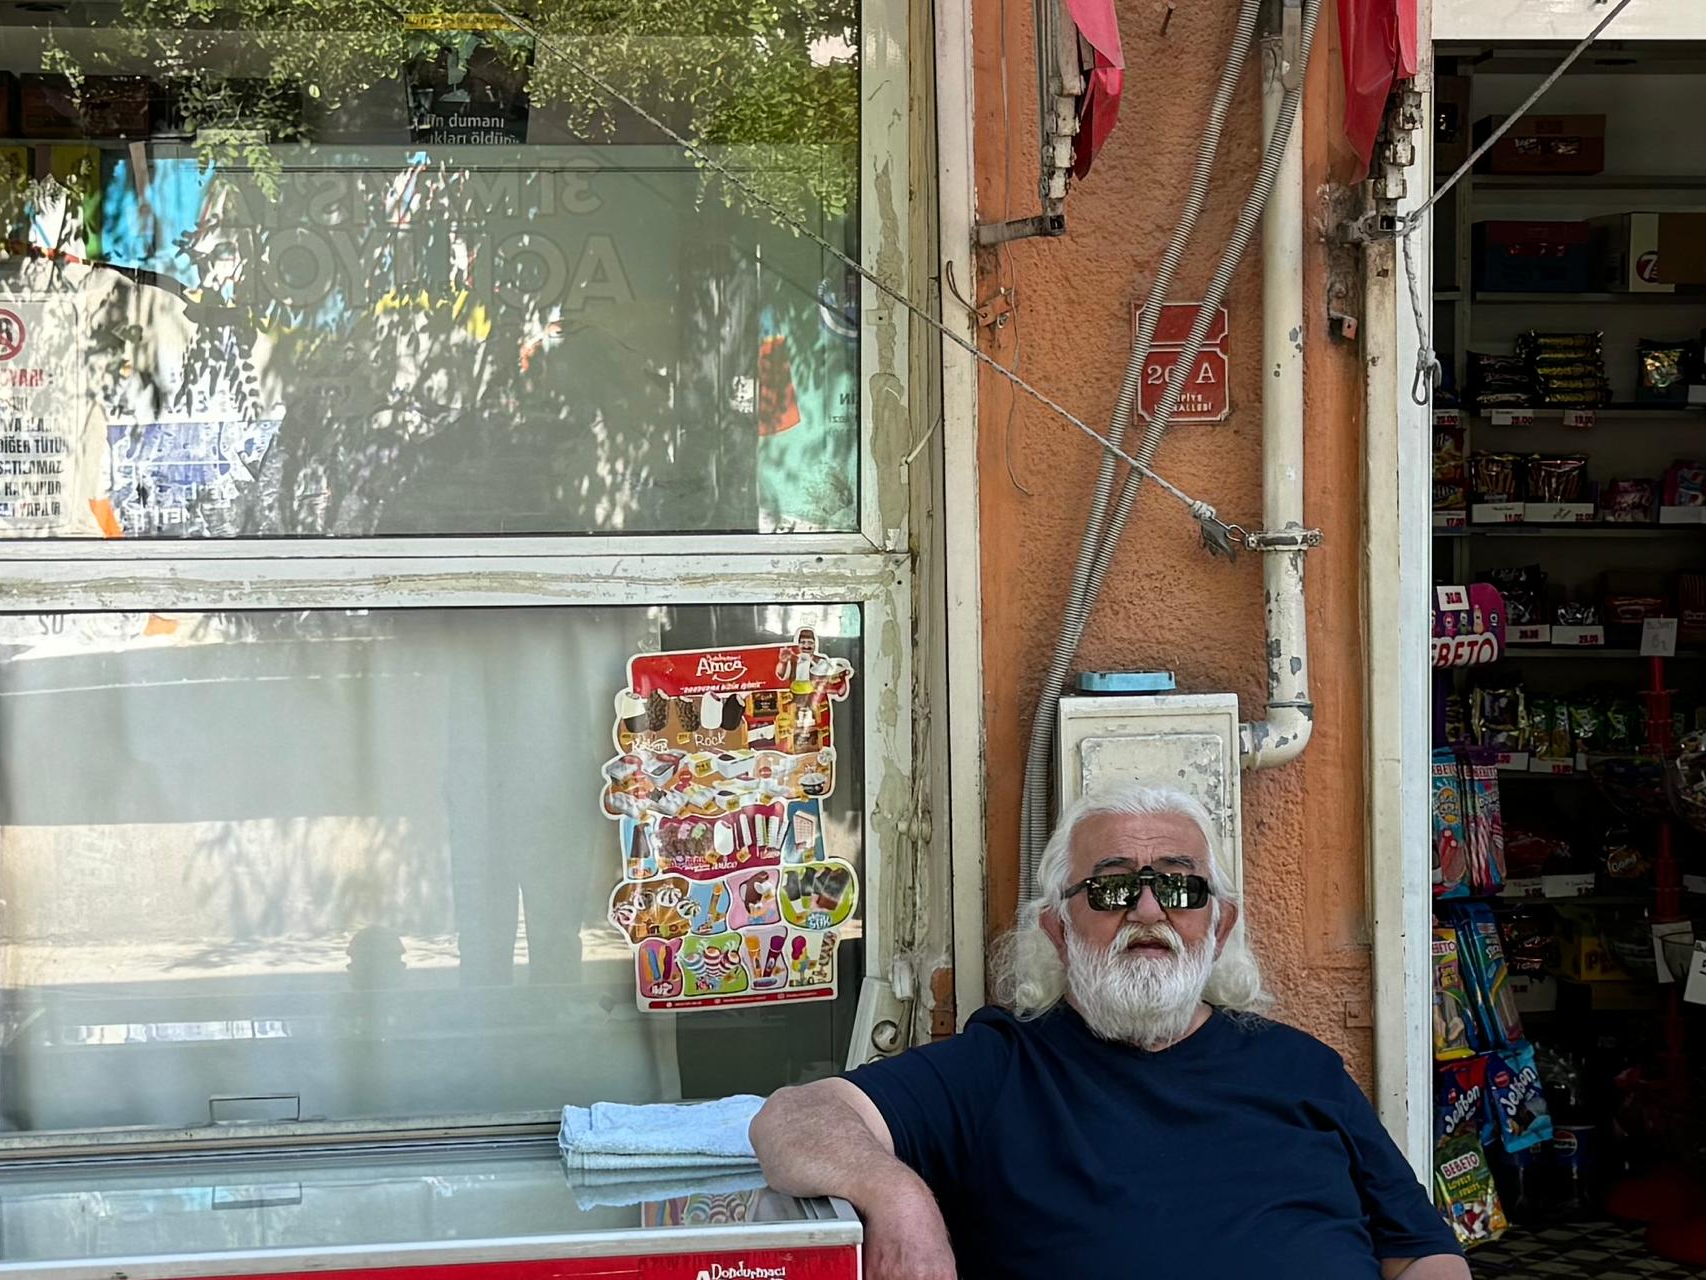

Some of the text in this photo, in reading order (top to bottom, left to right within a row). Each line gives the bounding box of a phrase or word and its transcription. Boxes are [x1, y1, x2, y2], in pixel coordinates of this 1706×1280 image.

[448, 113, 504, 128] dumanı
[1195, 362, 1216, 384] A
[696, 657, 744, 677] Amca
[694, 734, 726, 746] Rock
[1441, 1152, 1480, 1179] BEBETO
